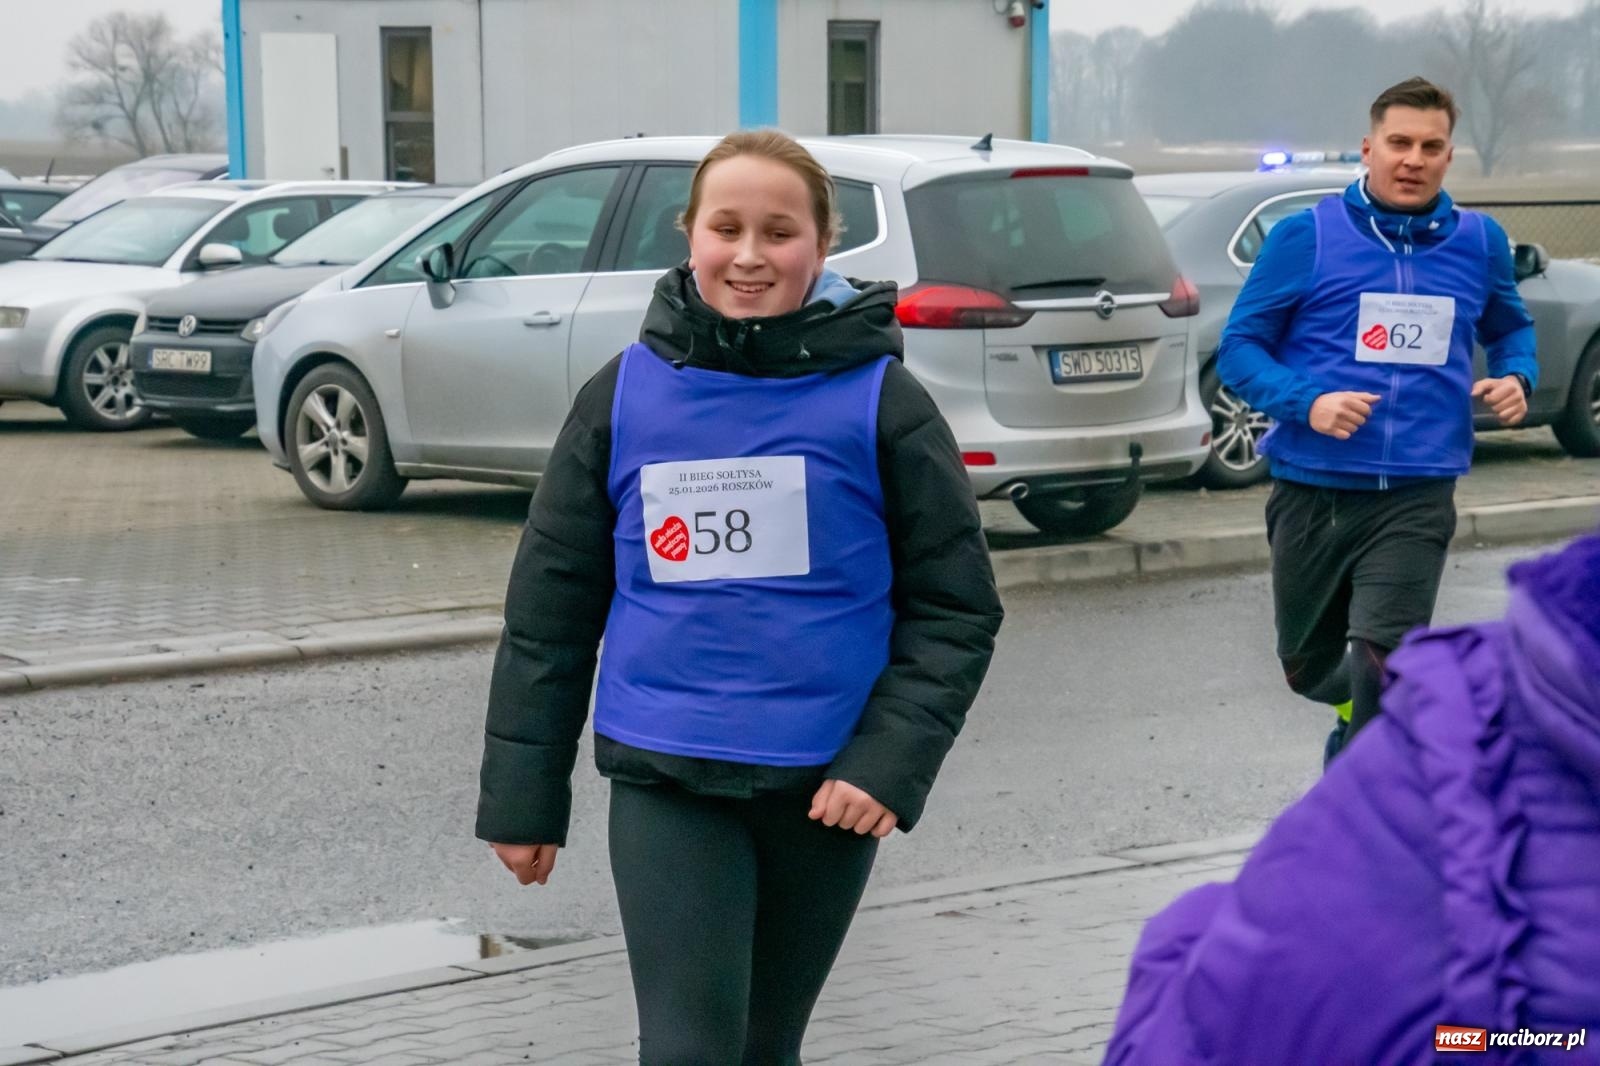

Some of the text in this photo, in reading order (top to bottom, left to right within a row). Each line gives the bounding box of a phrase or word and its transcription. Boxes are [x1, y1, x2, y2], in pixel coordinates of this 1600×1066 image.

[1390, 323, 1422, 349] 62
[1061, 350, 1140, 374] SWD 50315
[669, 480, 774, 495] 25.01.2026 ROSZKÓW
[690, 471, 714, 482] BIEG
[716, 470, 762, 480] SOŁTYSA
[694, 509, 753, 555] 58
